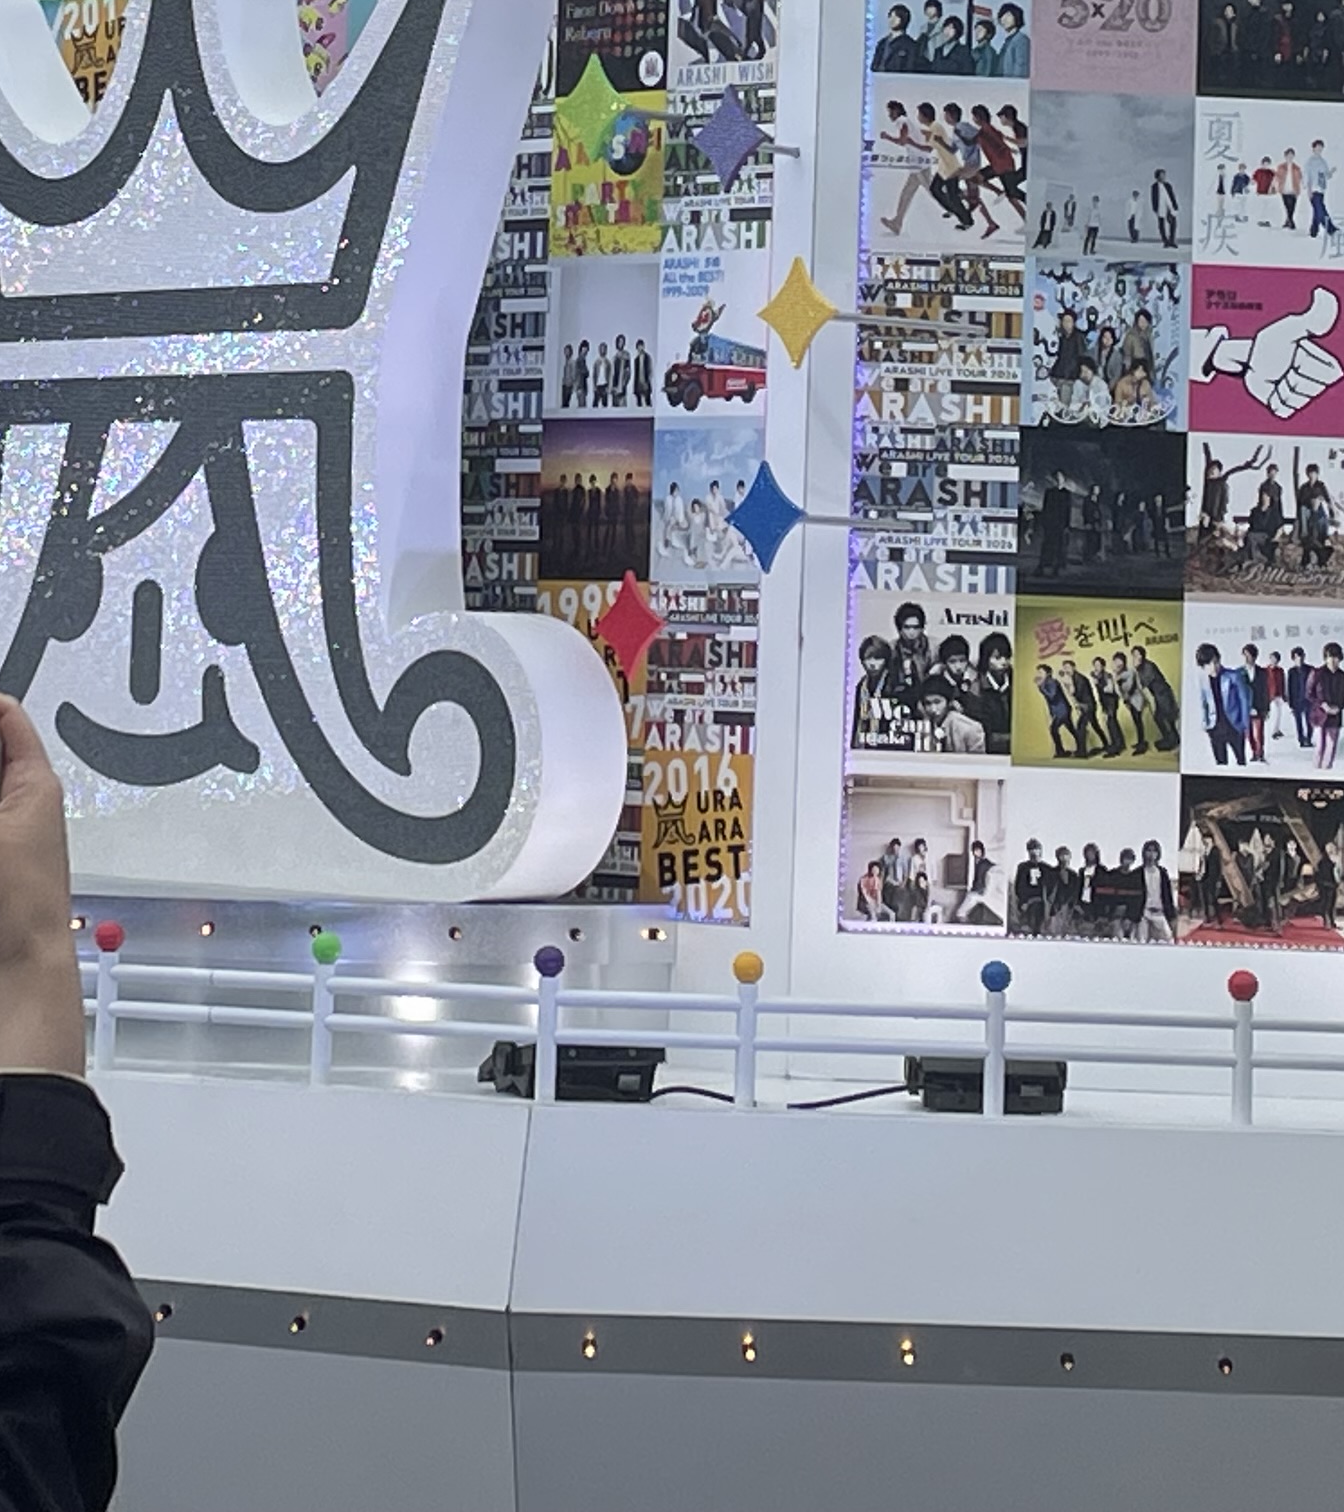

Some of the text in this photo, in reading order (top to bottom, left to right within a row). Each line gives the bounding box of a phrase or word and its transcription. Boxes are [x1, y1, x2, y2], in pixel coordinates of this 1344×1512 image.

[676, 62, 774, 86] ARASHI WISH
[1202, 112, 1240, 163] 夏
[661, 220, 772, 253] ARASHI
[1200, 215, 1240, 257] 疾
[855, 390, 1012, 425] ARASHI
[855, 476, 1009, 508] ARASHI
[849, 562, 1007, 595] ARASHI
[645, 723, 755, 754] ARASHI
[642, 750, 739, 807] 2016
[697, 786, 743, 814] URA
[698, 815, 745, 844] ARA
[658, 844, 745, 889] BEST
